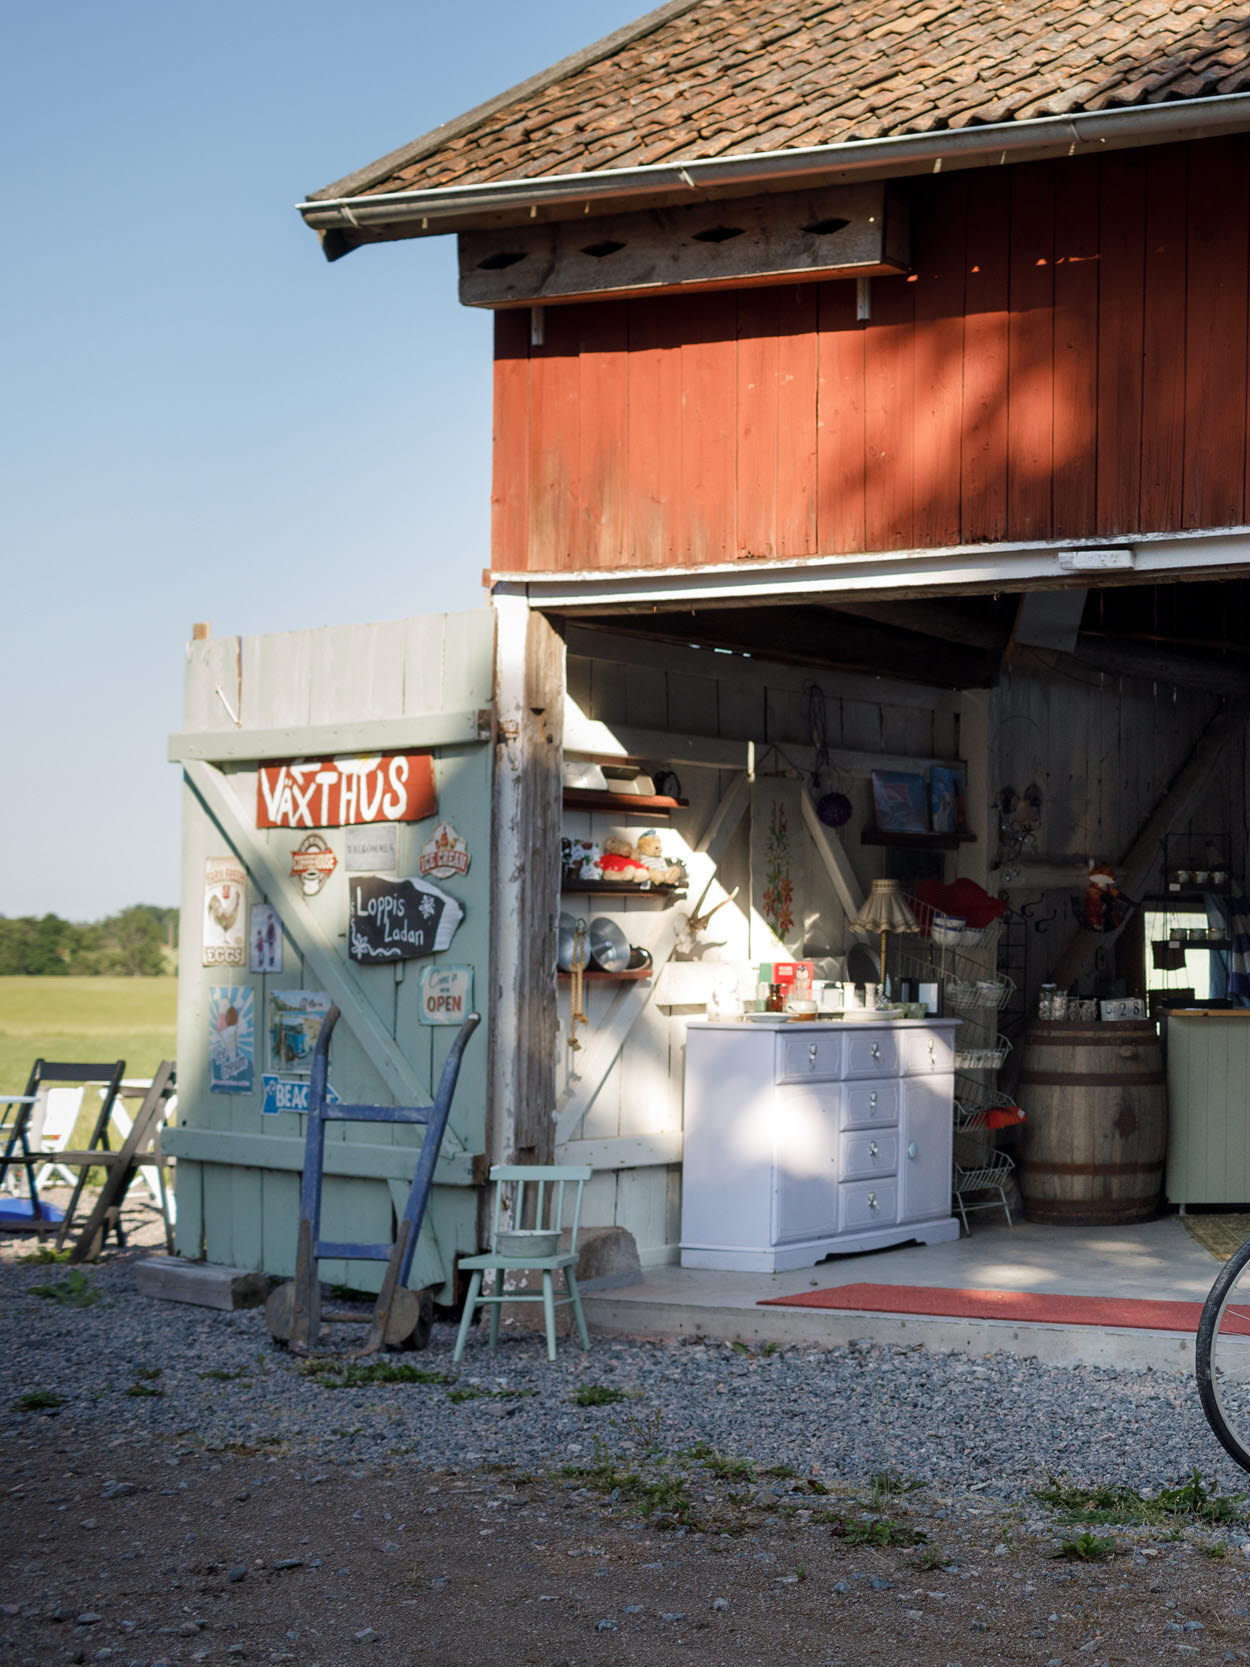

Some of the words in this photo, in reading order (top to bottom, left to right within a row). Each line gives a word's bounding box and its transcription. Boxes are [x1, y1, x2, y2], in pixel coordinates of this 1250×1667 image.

[260, 755, 409, 827] VÄXTHUS
[421, 852, 435, 870] ICE
[438, 850, 470, 868] CREAM
[356, 886, 405, 926] Loppis
[383, 918, 424, 946] Ladan
[207, 947, 241, 963] EGGS
[427, 995, 462, 1012] OPEN
[276, 1084, 309, 1108] BEAC
